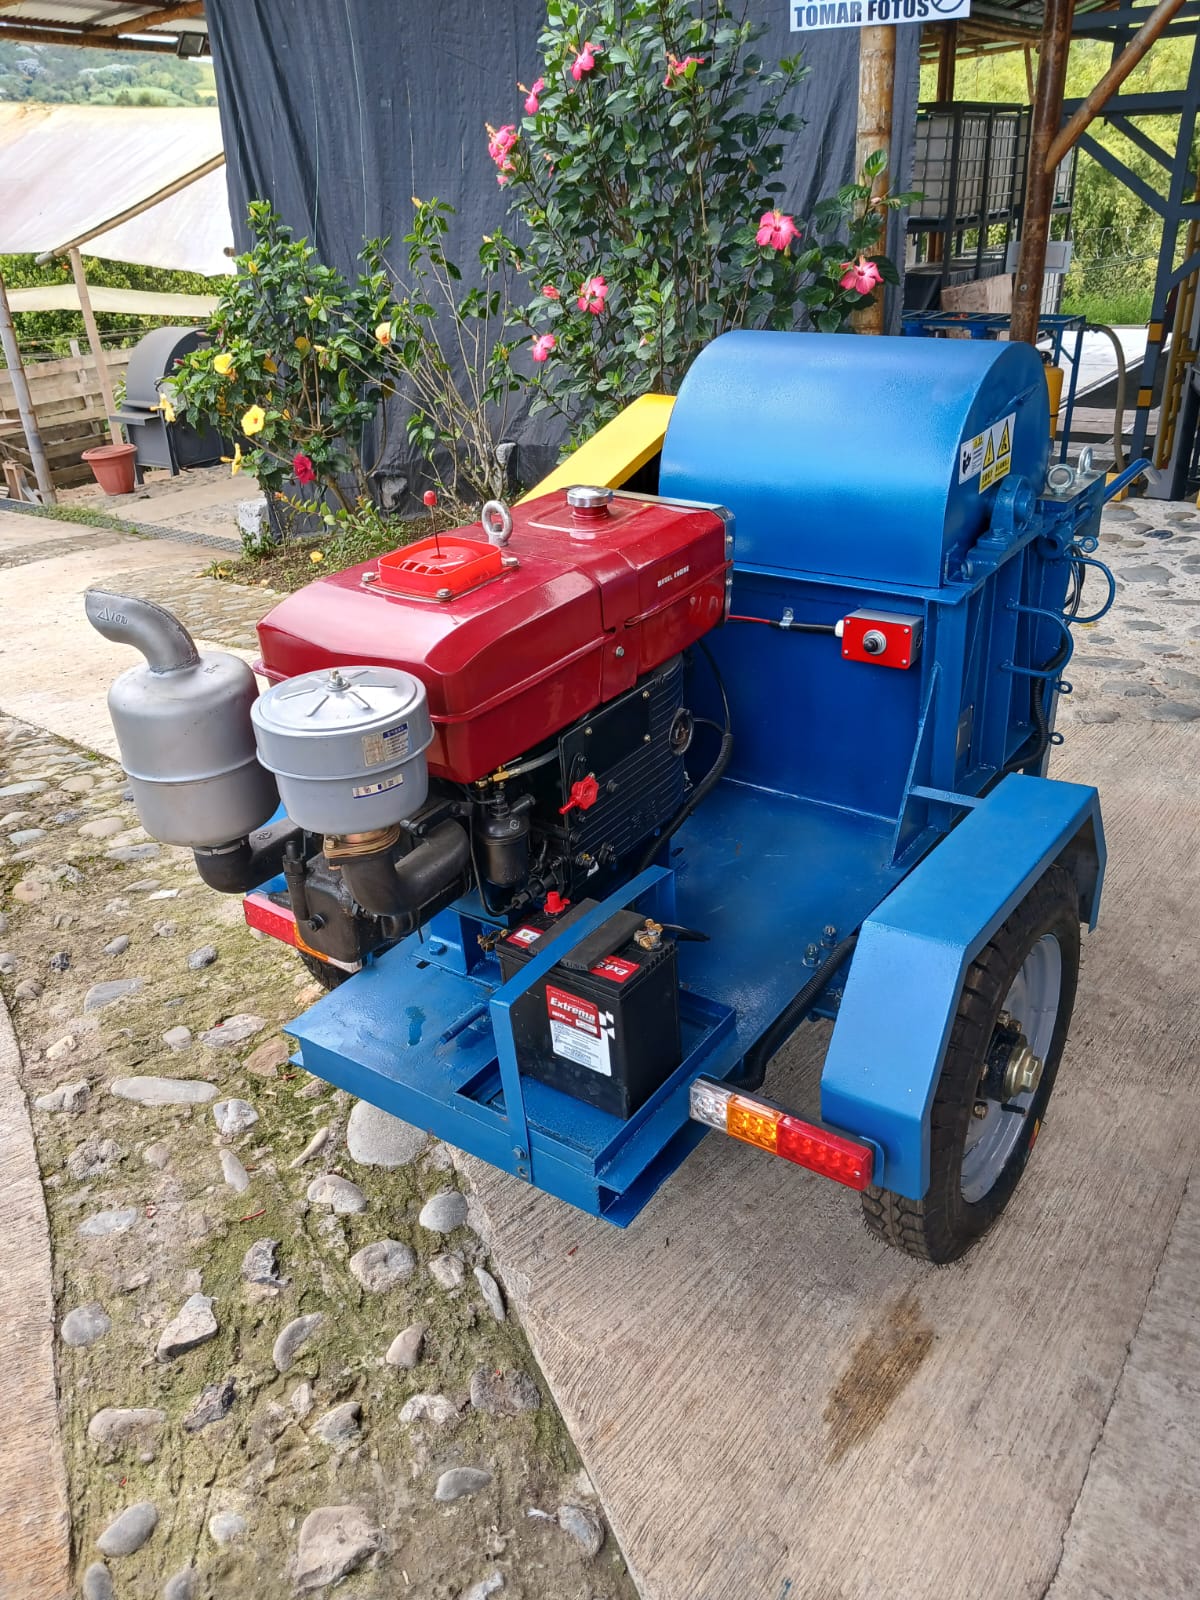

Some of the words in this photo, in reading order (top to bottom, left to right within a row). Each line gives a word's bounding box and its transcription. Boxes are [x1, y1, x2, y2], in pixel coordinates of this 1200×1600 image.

[794, 2, 862, 28] TOMAR
[867, 0, 929, 21] FOTOS
[550, 997, 596, 1022] Extrema
